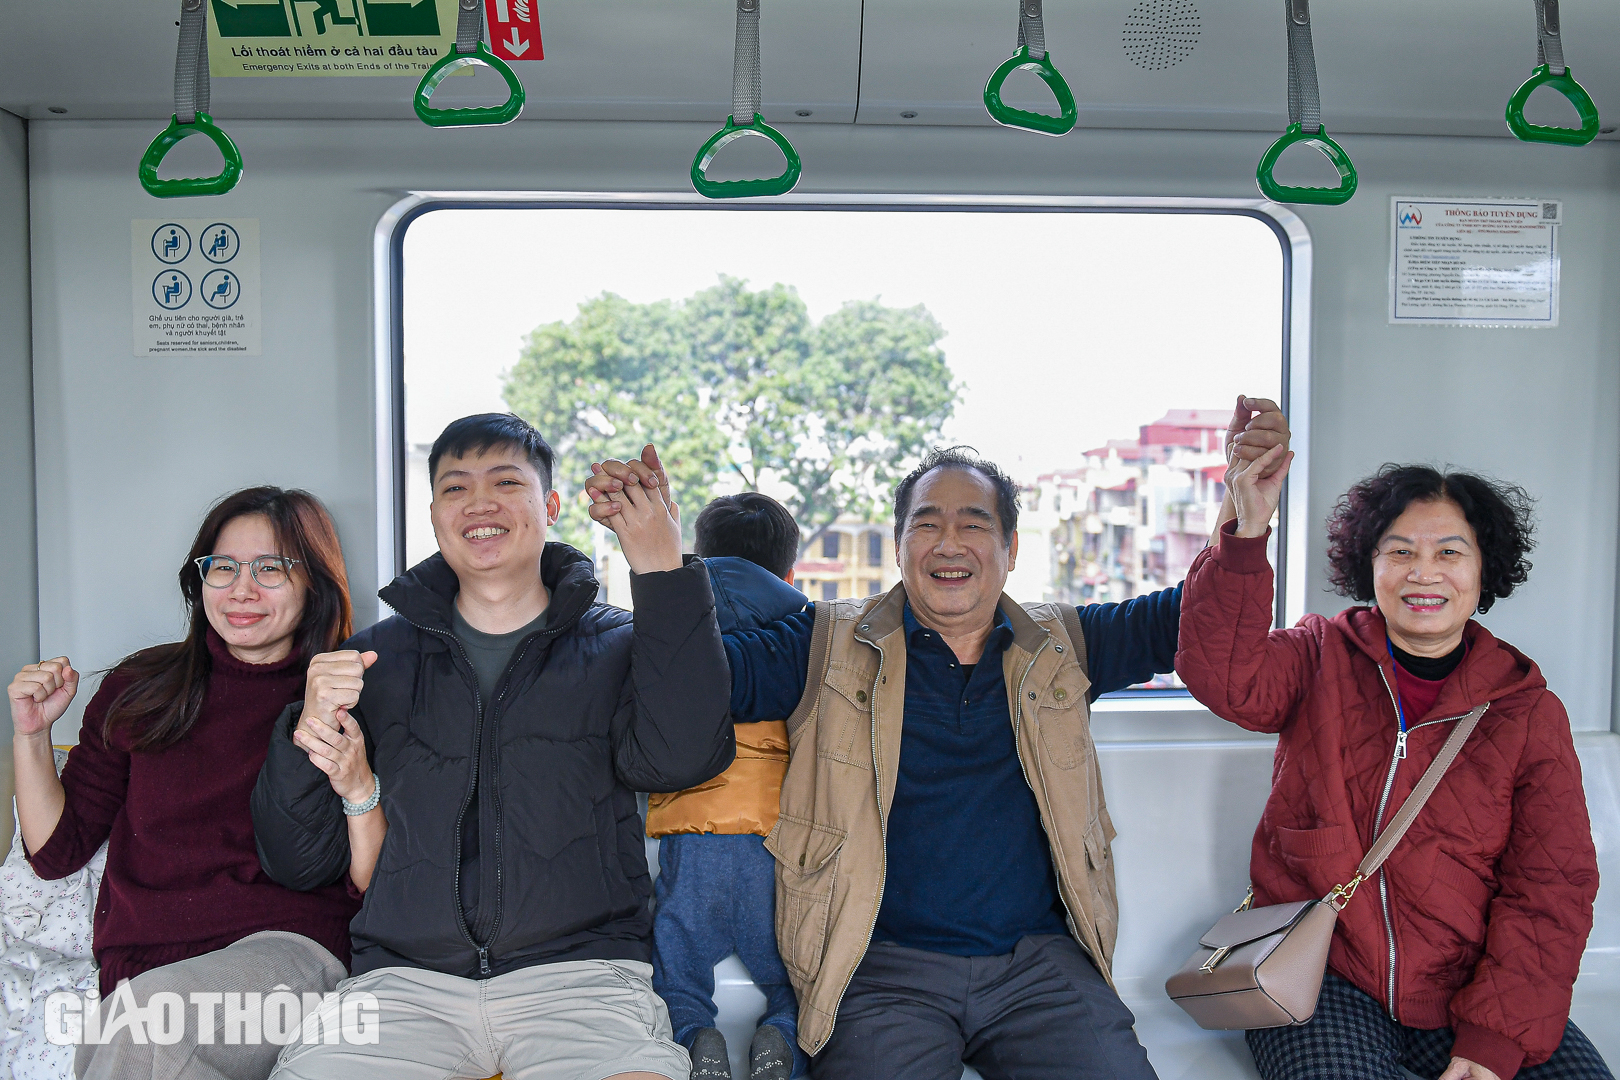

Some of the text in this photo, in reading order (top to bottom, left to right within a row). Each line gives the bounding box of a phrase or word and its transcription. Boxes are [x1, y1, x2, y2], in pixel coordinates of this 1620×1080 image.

[231, 44, 438, 56] Lối thoát hiểm ở cả hai đầu tàu
[242, 63, 294, 72] Emergency
[296, 62, 320, 70] Exits
[1445, 208, 1471, 216] THÔNG
